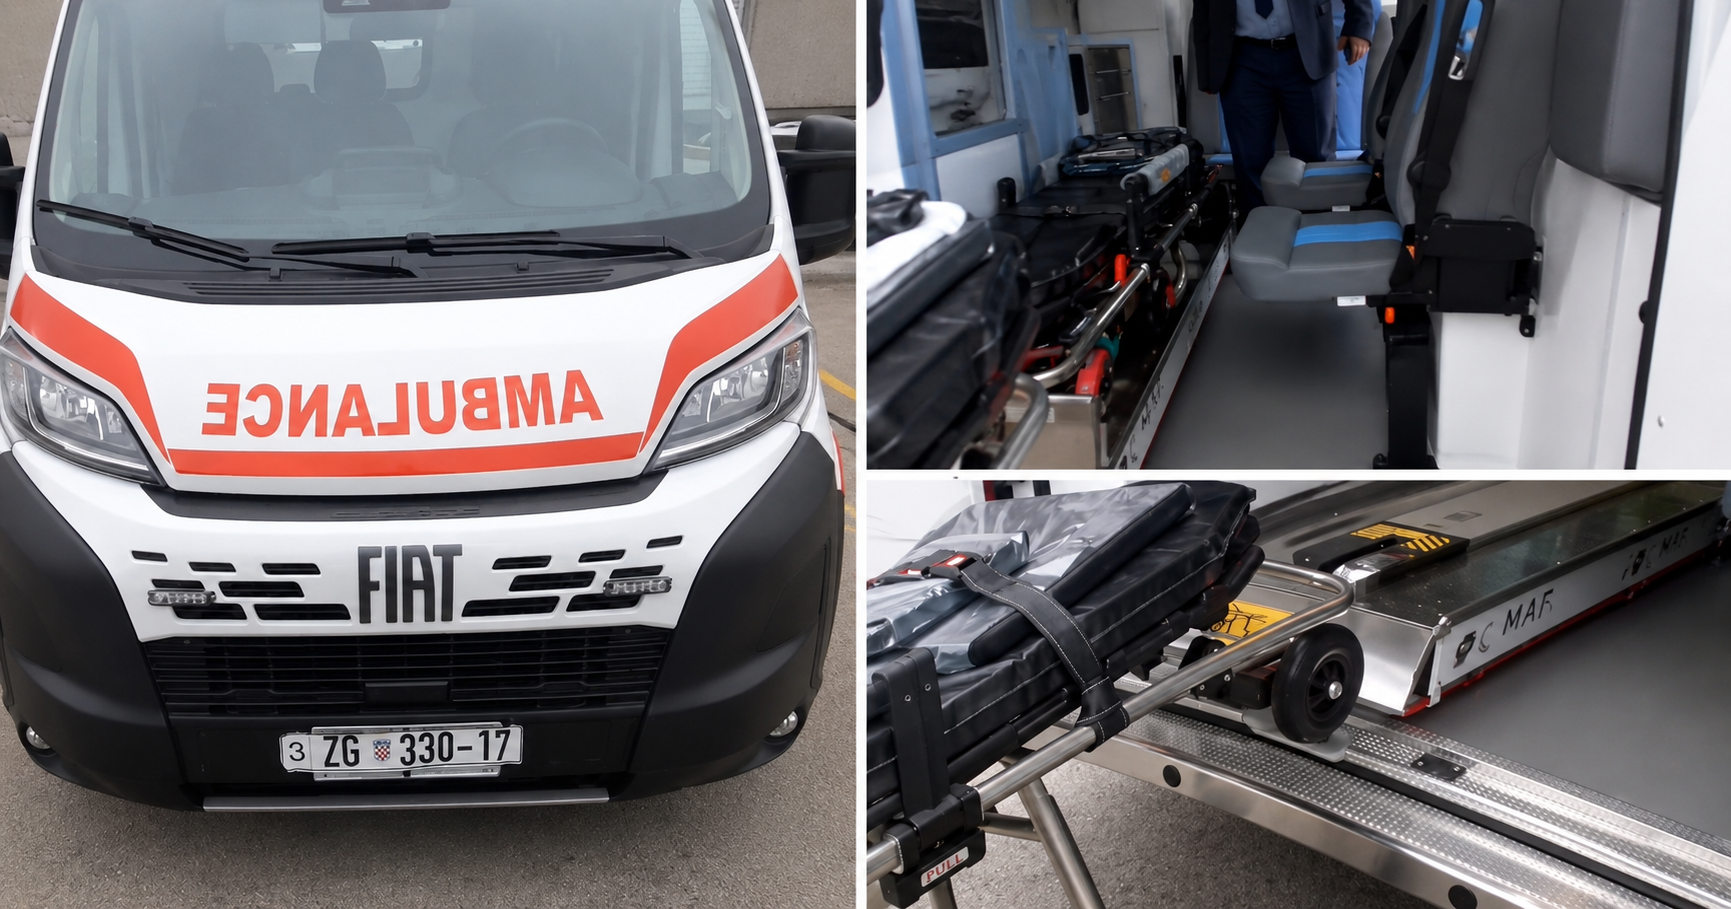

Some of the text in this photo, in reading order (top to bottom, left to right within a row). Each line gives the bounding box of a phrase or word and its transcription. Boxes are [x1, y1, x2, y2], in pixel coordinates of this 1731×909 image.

[358, 544, 463, 624] FIAT
[323, 734, 360, 767] ZG
[400, 729, 511, 766] 330-17
[926, 854, 964, 883] PULL
